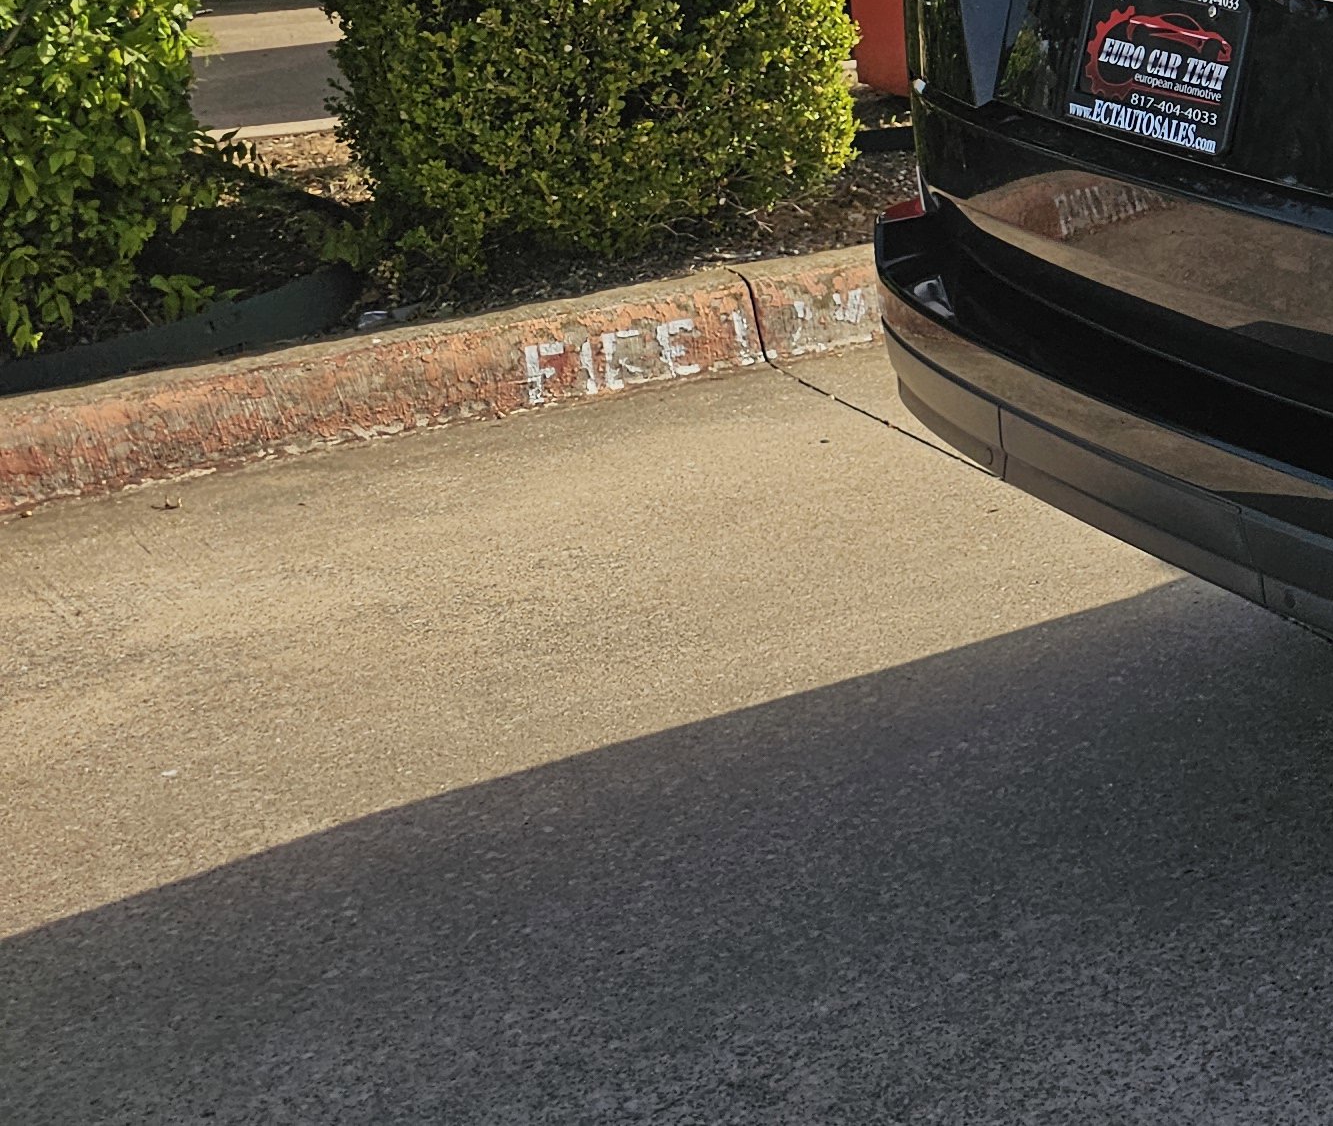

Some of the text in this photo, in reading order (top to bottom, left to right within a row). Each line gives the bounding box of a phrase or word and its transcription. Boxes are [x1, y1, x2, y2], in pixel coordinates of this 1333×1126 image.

[1098, 37, 1229, 91] EURO CAR TECH
[1130, 92, 1219, 126] 817-404-4033
[1134, 72, 1223, 102] european automotive
[1068, 98, 1217, 154] www.ECTAUTOSALES.com
